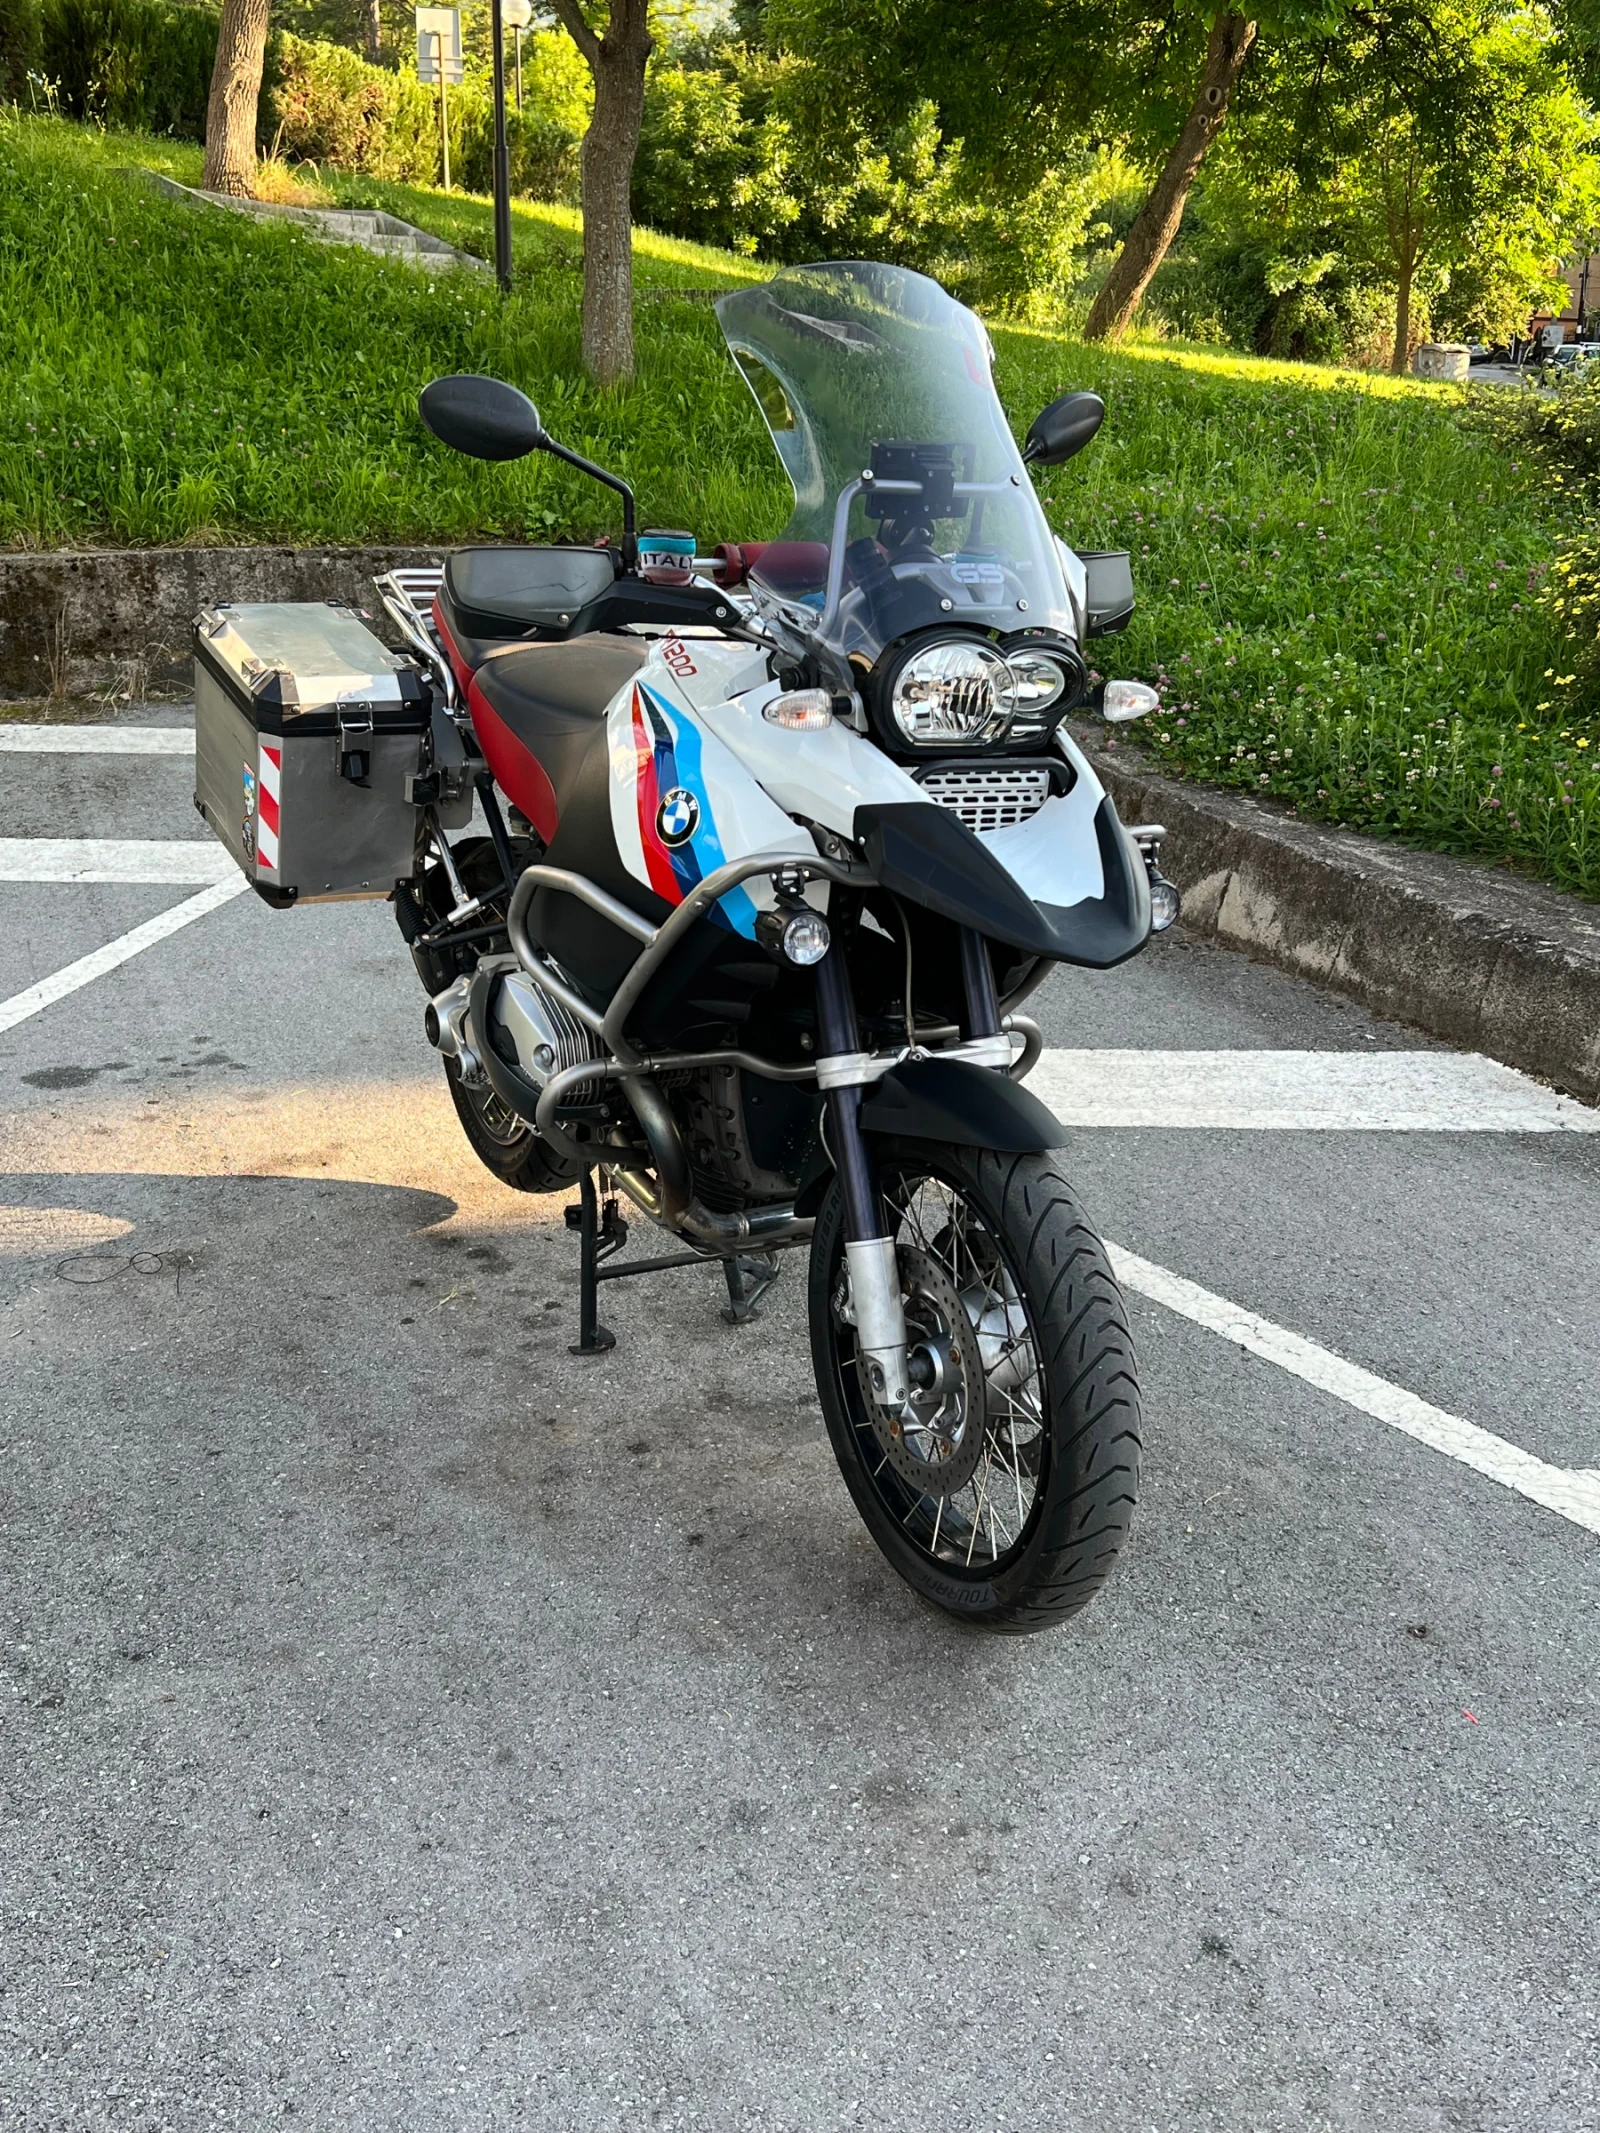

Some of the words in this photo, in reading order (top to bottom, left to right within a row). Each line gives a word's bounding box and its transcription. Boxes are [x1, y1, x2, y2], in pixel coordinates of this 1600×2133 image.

[950, 563, 1004, 583] GS
[664, 791, 698, 811] BMW
[833, 1283, 846, 1312] BMW
